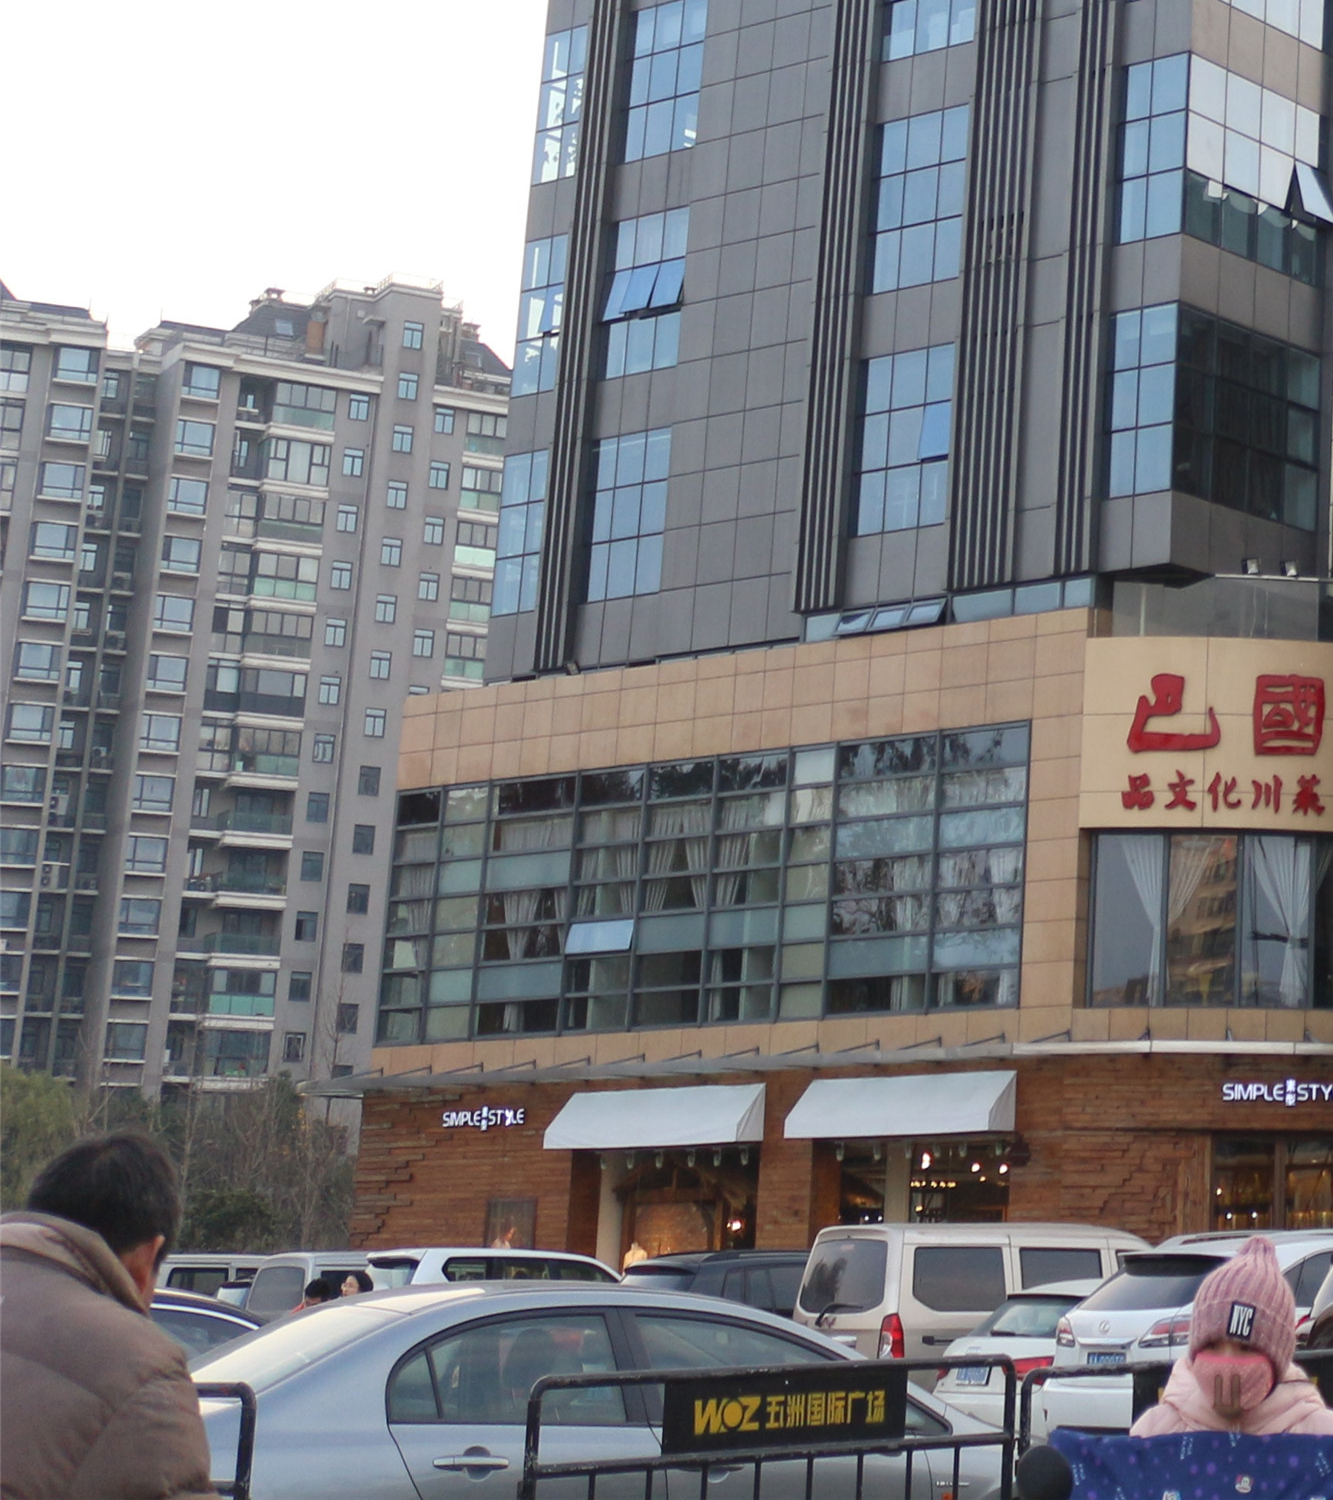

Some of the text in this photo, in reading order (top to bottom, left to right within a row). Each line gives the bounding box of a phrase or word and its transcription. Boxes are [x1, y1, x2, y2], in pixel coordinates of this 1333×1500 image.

[1121, 772, 1326, 817] 品文化川菜
[1222, 1083, 1284, 1101] SIMPLE
[442, 1110, 481, 1128] SIMPLE
[488, 1108, 525, 1127] STYLE
[1230, 1304, 1254, 1337] NYC
[694, 1389, 885, 1436] WOZ 五洲国际广场
